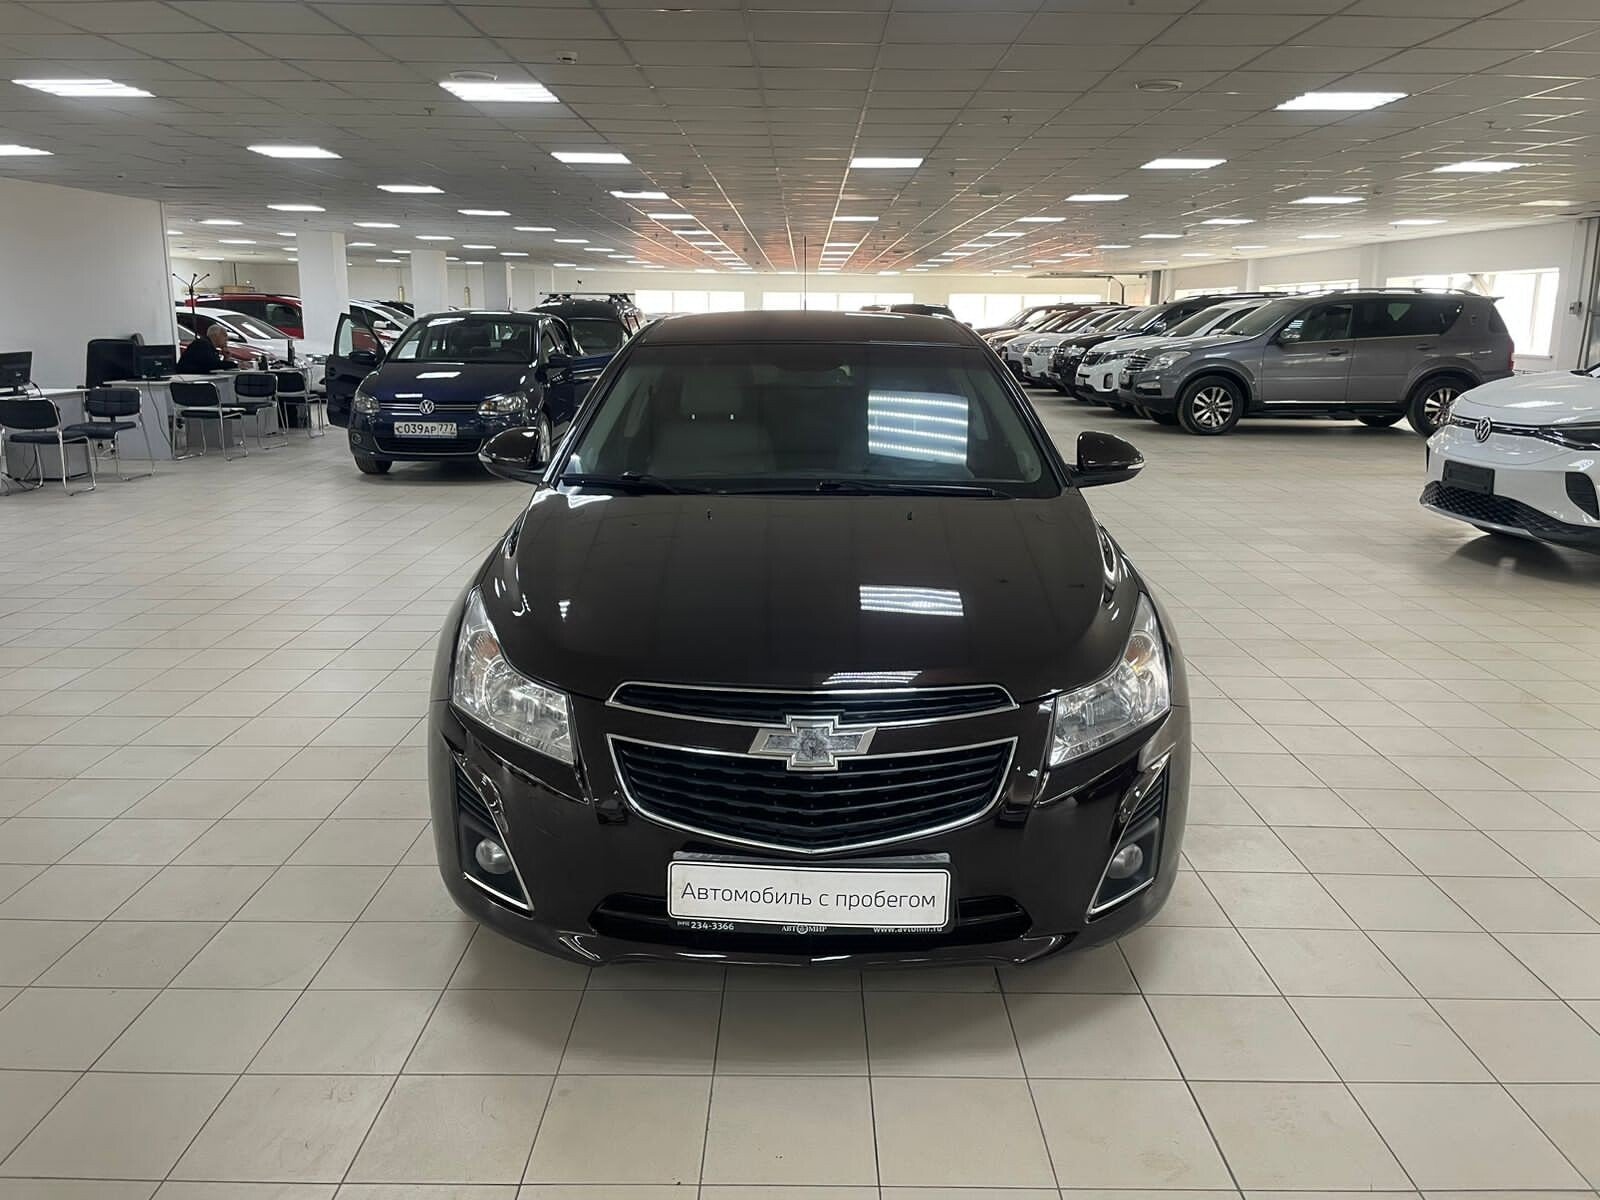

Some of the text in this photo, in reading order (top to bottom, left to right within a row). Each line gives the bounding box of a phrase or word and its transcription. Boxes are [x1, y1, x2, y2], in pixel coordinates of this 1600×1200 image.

[439, 424, 453, 432] 777
[681, 882, 936, 911] Автомобиль с пробегом
[691, 921, 735, 930] 234-3366
